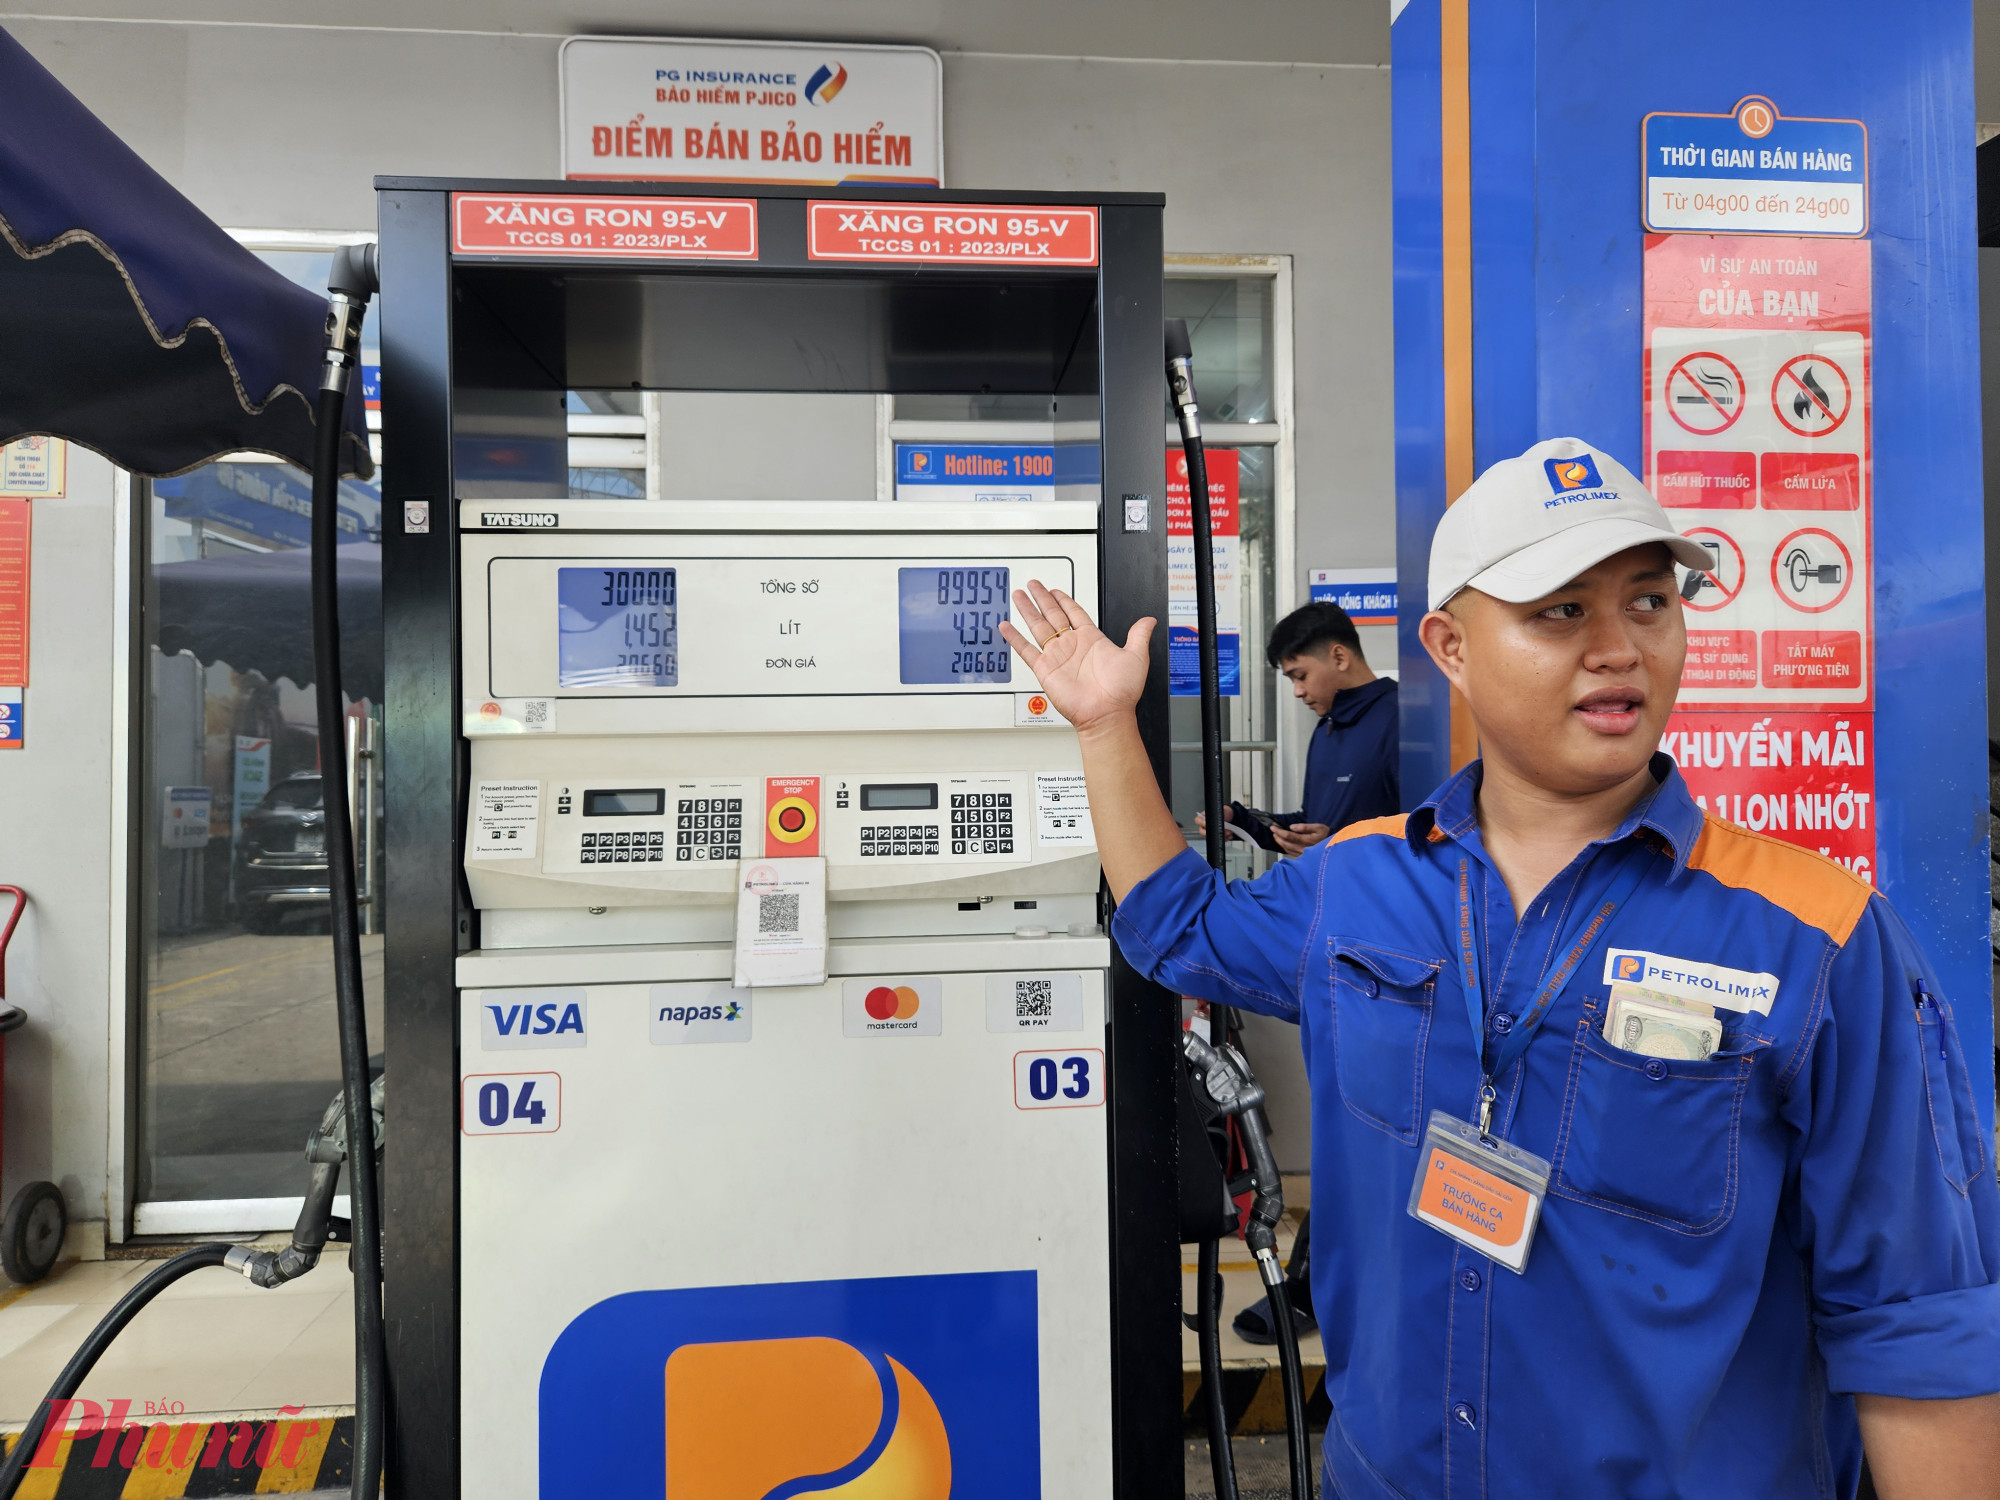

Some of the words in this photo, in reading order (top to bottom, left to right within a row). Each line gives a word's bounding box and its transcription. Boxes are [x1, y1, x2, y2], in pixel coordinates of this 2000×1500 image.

[656, 70, 680, 82] PG
[686, 71, 796, 84] INSURANCE
[656, 85, 691, 102] BẢO
[697, 84, 740, 105] HIỂM
[747, 91, 796, 107] PJICO
[592, 114, 672, 157] ĐIỂM
[685, 121, 749, 160] BÁN
[761, 120, 822, 162] BẢO
[834, 121, 911, 166] HIỂM
[1660, 143, 1706, 167] THỜI
[1711, 149, 1754, 168] GIAN
[1760, 147, 1797, 170] BÁN
[1802, 148, 1852, 172] HÀNG
[1663, 192, 1688, 210] Từ
[1693, 194, 1749, 215] 04g00
[1755, 194, 1789, 213] đến
[1795, 197, 1850, 218] 24g00
[485, 203, 575, 226] XĂNG
[585, 208, 652, 227] RON
[662, 211, 727, 229] 95-V
[838, 211, 924, 234] XĂNG
[934, 217, 998, 235] RON
[1007, 219, 1069, 237] 95-V
[506, 231, 564, 246] TCCS
[570, 233, 593, 246] 01
[613, 234, 707, 248] 2023/PLX
[858, 239, 914, 253] TCCS
[920, 240, 940, 253] 01
[960, 241, 1050, 256] 2023/PLX
[1700, 254, 1716, 274] VÌ
[1720, 258, 1745, 278] SỰ
[1749, 259, 1772, 276] AN
[1775, 256, 1818, 276] TOÀN
[1698, 281, 1754, 316] CỦA
[1763, 290, 1819, 323] BẠN
[945, 455, 1008, 476] Hotline:
[1013, 455, 1053, 476] 1900
[1663, 472, 1688, 488] CẤM
[1690, 474, 1712, 488] HÚT
[1714, 473, 1750, 488] THUỐC
[1784, 474, 1809, 489] CẤM
[1812, 475, 1836, 490] LỬA
[1544, 491, 1622, 509] PETROLIMEX
[484, 513, 556, 527] TATSUNO
[601, 571, 676, 606] 30000
[760, 579, 796, 594] TỔNG
[802, 579, 820, 594] SỐ
[938, 571, 1008, 605] 89954
[1339, 591, 1362, 610] UỐNG
[1363, 591, 1392, 610] KHÁCH
[780, 619, 801, 635] LÍT
[1707, 636, 1730, 649] VỰC
[1787, 641, 1808, 658] TẮT
[1811, 644, 1835, 658] MÁY
[795, 656, 816, 668] GIÁ
[951, 652, 1008, 674] 20660
[1703, 650, 1719, 664] SỬ
[1721, 653, 1749, 666] DỤNG
[1686, 669, 1714, 682] THOẠI
[1716, 669, 1727, 680] DI
[1728, 667, 1756, 682] ĐỘNG
[1773, 664, 1823, 677] PHƯƠNG
[1826, 662, 1850, 679] TIỆN
[1660, 717, 1792, 767] KHUYẾN
[1802, 721, 1864, 766] MÃI
[772, 779, 815, 787] EMERGENCY
[682, 802, 690, 812] 7
[697, 801, 706, 811] 8
[714, 801, 722, 811] 9
[730, 802, 739, 810] F1
[954, 796, 961, 806] 7
[969, 796, 977, 806] 8
[985, 795, 993, 805] 9
[1734, 793, 1788, 831] LON
[1795, 783, 1870, 830] NHỚT
[681, 817, 689, 827] 4
[697, 817, 705, 826] 5
[714, 817, 722, 827] 6
[954, 811, 962, 821] 4
[970, 811, 978, 821] 5
[985, 811, 993, 820] 6
[583, 835, 595, 845] P1
[600, 835, 612, 844] P2
[617, 835, 629, 844] P3
[633, 834, 646, 843] P4
[650, 834, 663, 843] P5
[682, 833, 687, 843] 1
[697, 833, 705, 843] 2
[713, 832, 722, 843] 3
[729, 833, 739, 841] F3
[862, 829, 873, 838] P1
[878, 829, 890, 838] P2
[894, 829, 906, 837] P3
[910, 828, 922, 837] P4
[926, 828, 938, 836] P5
[955, 827, 961, 837] 1
[970, 827, 978, 837] 2
[986, 826, 994, 836] 3
[1001, 827, 1011, 835] F3
[582, 851, 595, 860] P6
[600, 851, 612, 860] P7
[616, 851, 628, 860] P8
[633, 851, 645, 859] P9
[648, 851, 663, 859] P10
[680, 849, 687, 859] 0
[696, 848, 705, 859] C
[728, 849, 739, 857] F4
[862, 845, 874, 853] P6
[878, 845, 890, 853] P7
[894, 844, 906, 853] P8
[910, 844, 922, 852] P9
[925, 843, 939, 852] P10
[955, 843, 962, 852] 0
[970, 842, 979, 852] C
[485, 1003, 584, 1036] VISA
[659, 1005, 722, 1025] napas
[867, 1020, 918, 1030] mastercard
[1029, 1057, 1090, 1101] 03
[478, 1081, 546, 1127] 04
[1442, 1181, 1487, 1213] TRƯỞNG
[1489, 1208, 1504, 1222] CA
[1441, 1197, 1464, 1217] BÁN
[1466, 1209, 1497, 1233] HÀNG
